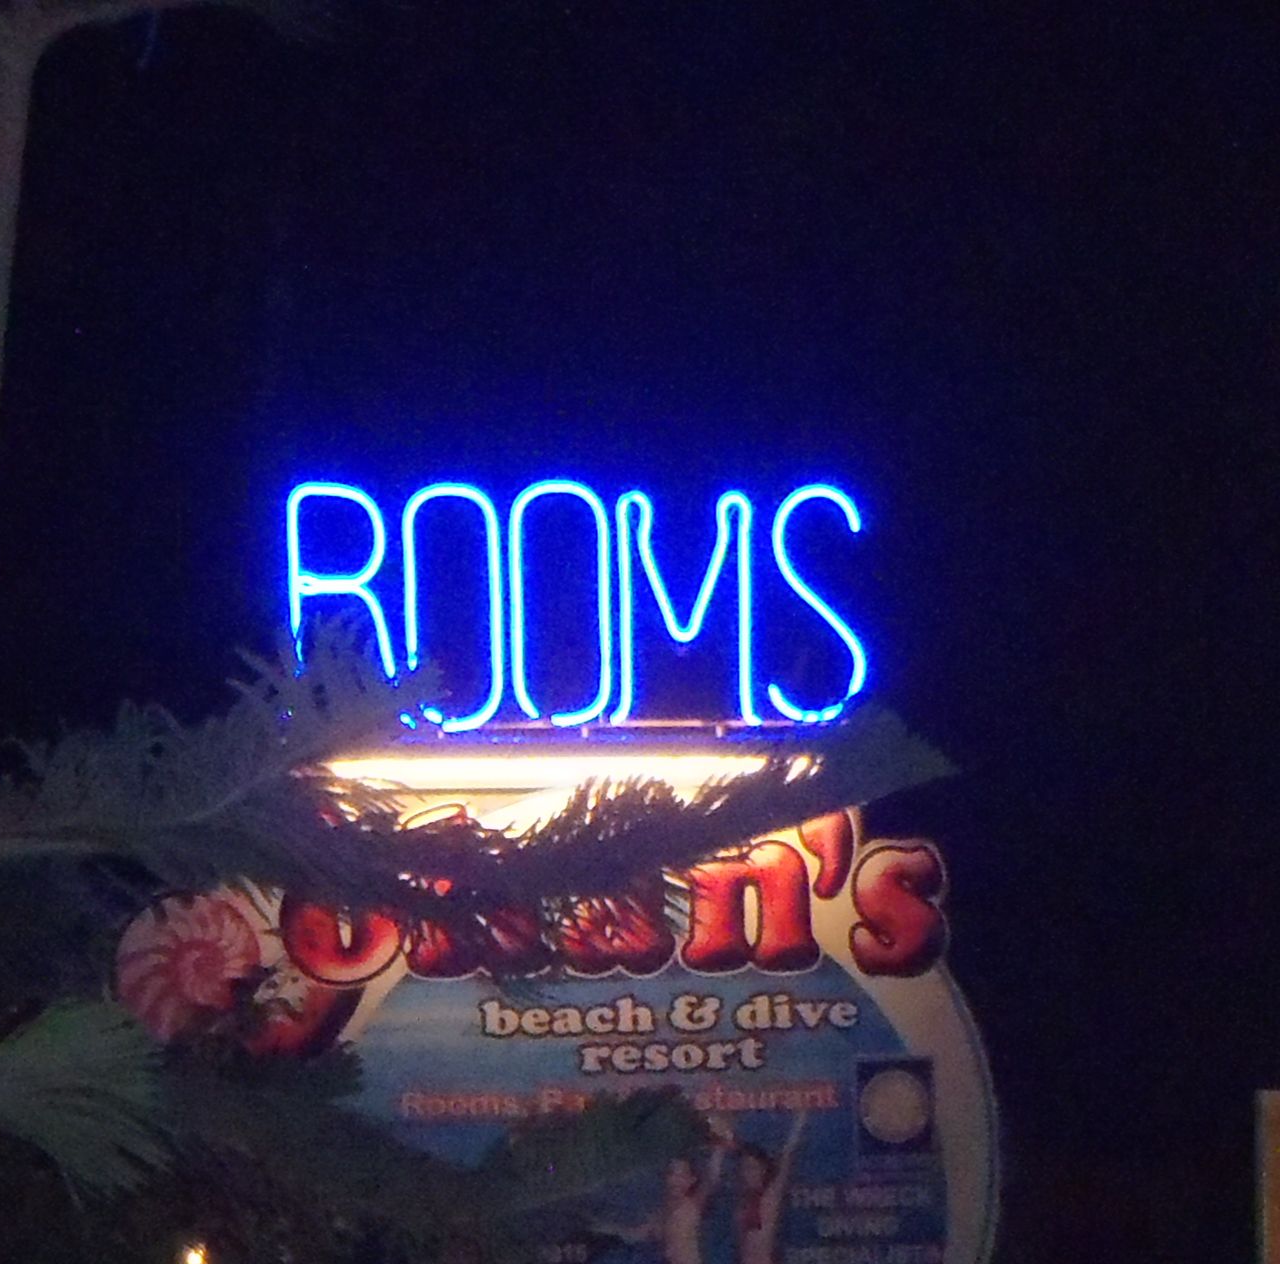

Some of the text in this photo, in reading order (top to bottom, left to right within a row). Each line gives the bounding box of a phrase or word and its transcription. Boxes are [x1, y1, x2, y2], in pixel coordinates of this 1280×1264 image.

[286, 480, 867, 734] ROOMS
[480, 994, 860, 1037] beach & dive
[580, 1037, 766, 1073] resort
